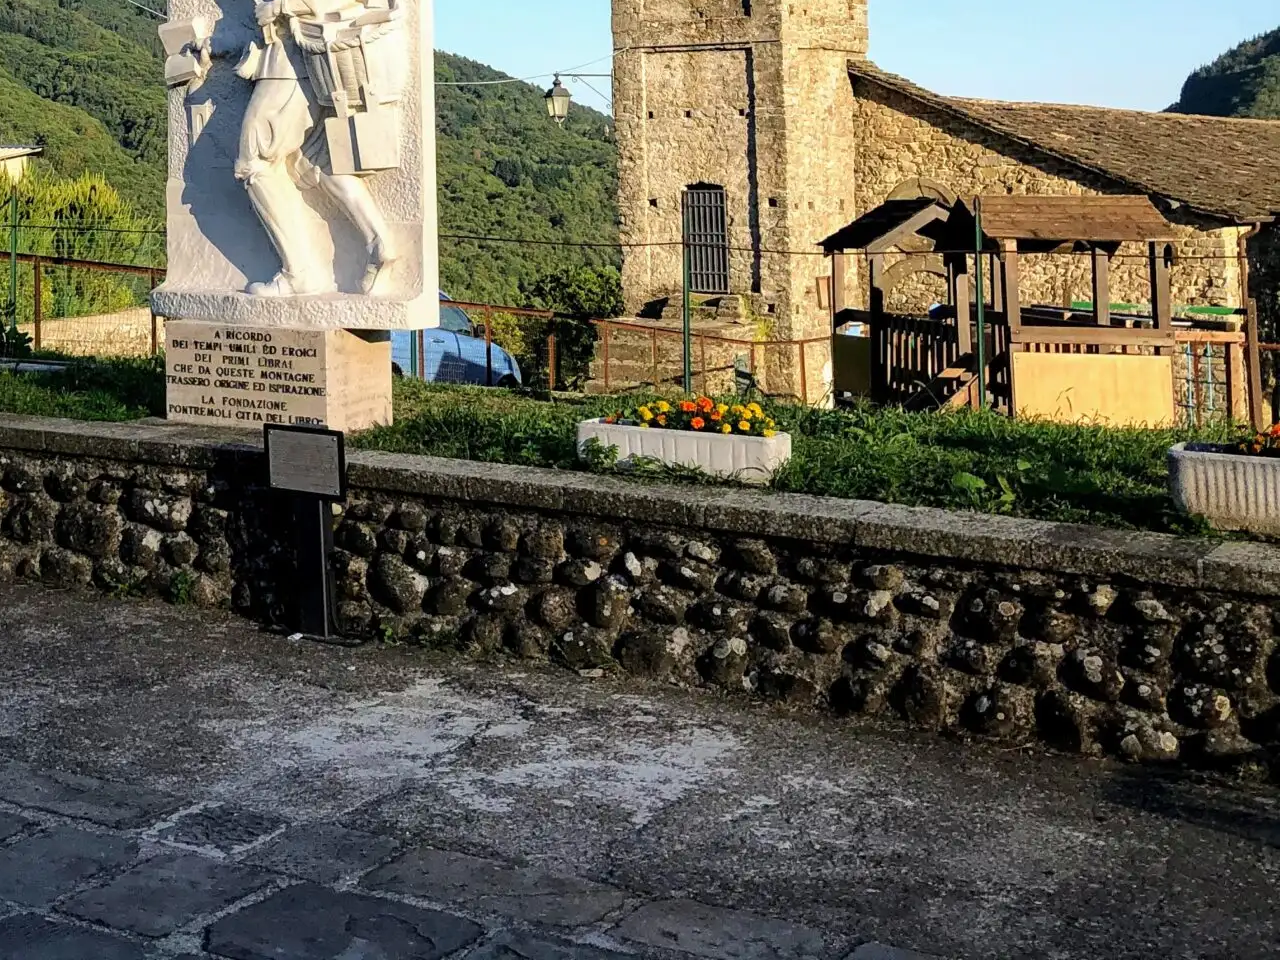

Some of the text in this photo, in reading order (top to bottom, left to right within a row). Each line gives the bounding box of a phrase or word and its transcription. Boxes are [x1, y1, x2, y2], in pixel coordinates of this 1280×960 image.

[214, 330, 272, 342] A RICORDO
[172, 340, 317, 357] DEI TEMPI UMILI ED EROICI
[195, 354, 293, 369] DEI PRIMI LIBRAI
[173, 364, 315, 383] CHE DA QUESTE MONTAGNE
[167, 375, 326, 397] TRASSERO ORIGINE ED ISPIRAZIONE
[201, 395, 288, 411] LA FONDAZIONE
[169, 404, 231, 419] PONTREMOLI
[266, 414, 285, 424] DEL
